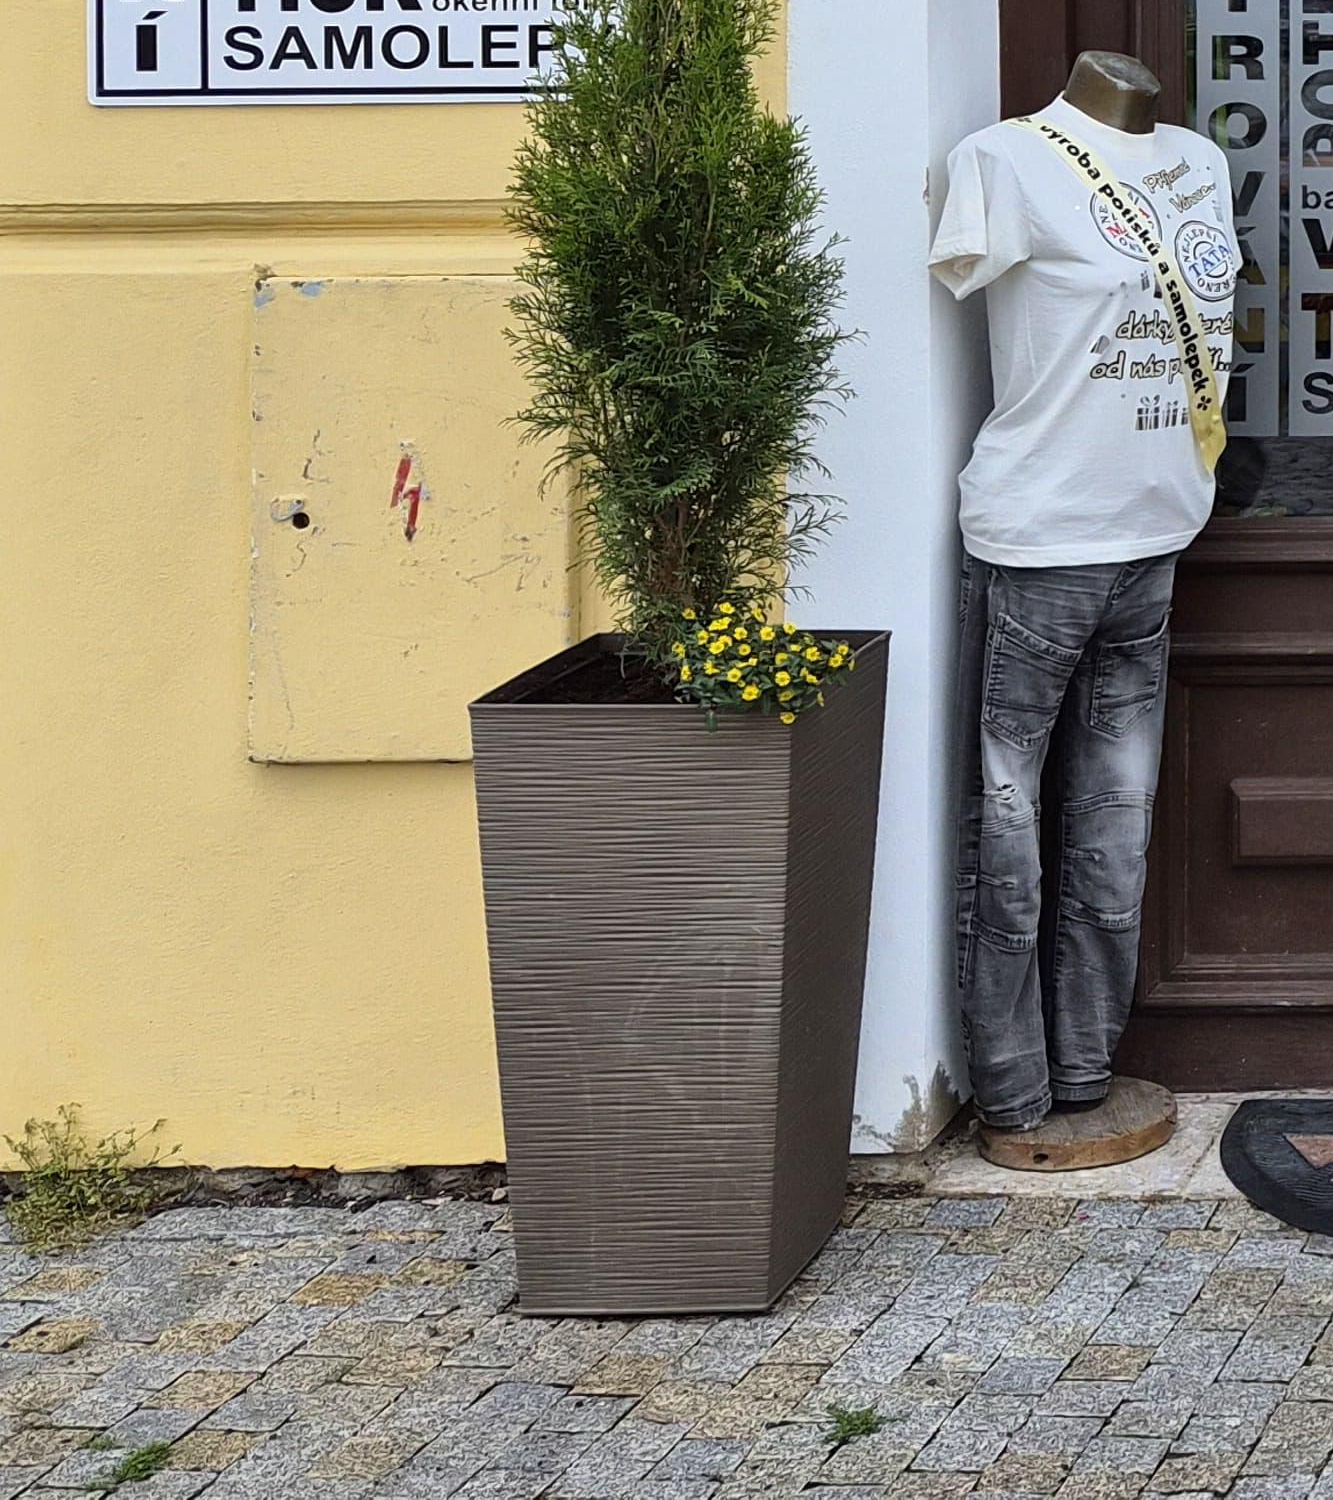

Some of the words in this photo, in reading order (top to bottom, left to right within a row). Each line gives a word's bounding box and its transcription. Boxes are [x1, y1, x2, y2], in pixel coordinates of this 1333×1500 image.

[224, 24, 616, 70] SAMOLEP
[1097, 183, 1161, 257] potisků
[1157, 261, 1170, 276] a
[1165, 278, 1210, 395] samolepek
[1089, 349, 1127, 380] od
[1129, 353, 1167, 380] nás
